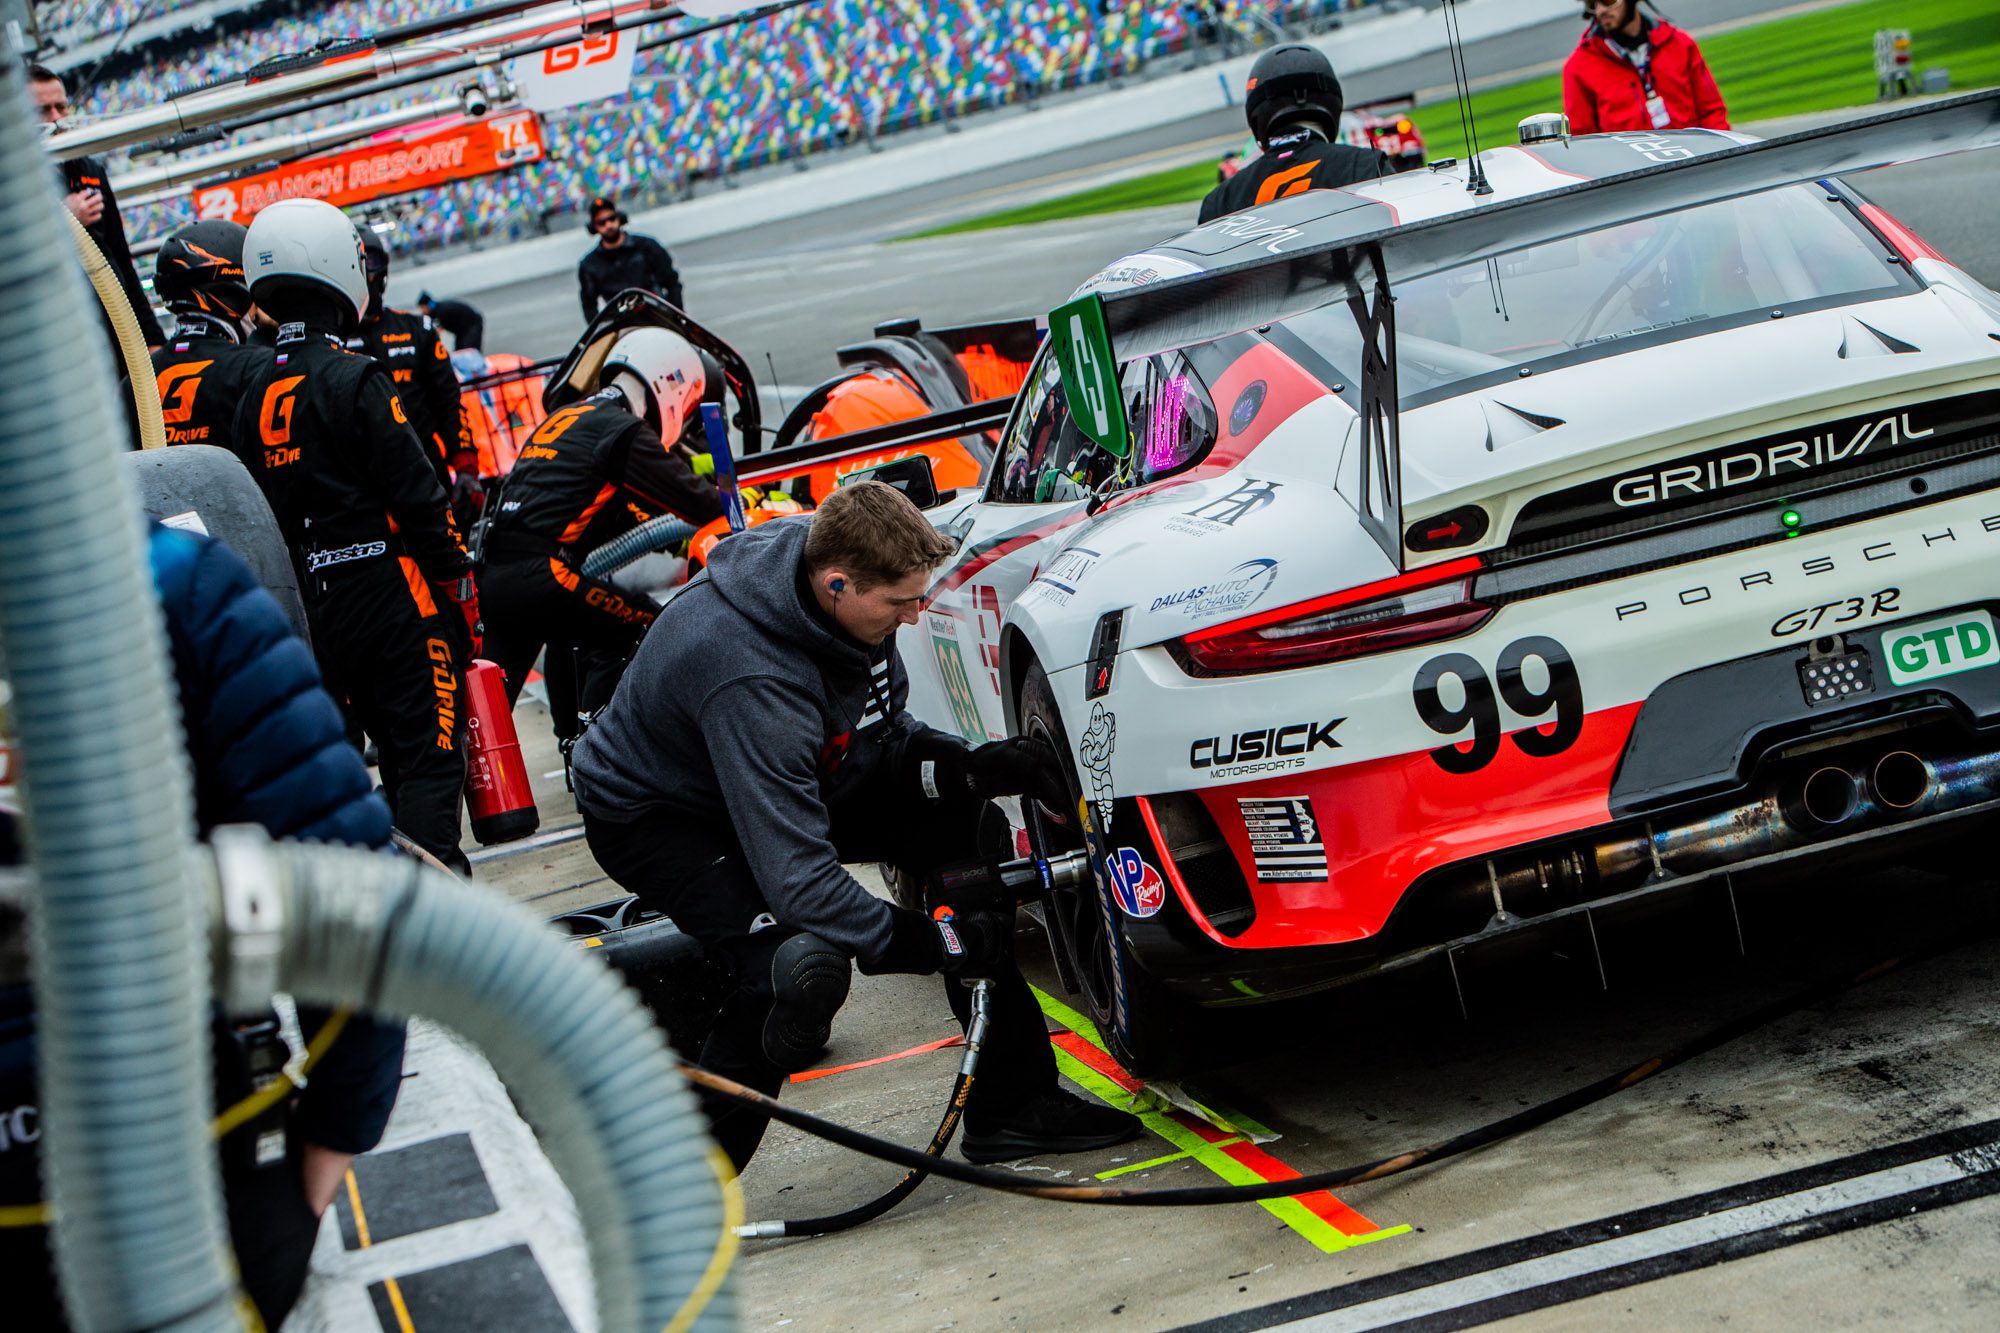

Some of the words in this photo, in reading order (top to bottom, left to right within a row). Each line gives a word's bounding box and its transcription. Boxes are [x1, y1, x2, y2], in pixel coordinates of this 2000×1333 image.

[241, 164, 345, 215] RANCH
[347, 137, 468, 190] RESORT
[166, 426, 210, 444] DRIVE
[1612, 412, 1935, 508] GRIDRIVAL
[307, 540, 386, 573] lpinestars
[1615, 514, 2000, 622] PORSCHE
[1149, 586, 1208, 613] DALLAS
[1205, 578, 1250, 596] AUTO
[1183, 589, 1255, 615] EXCHANGE
[1890, 621, 1993, 674] GTD
[938, 643, 982, 736] 99
[1413, 635, 1584, 775] 99
[1190, 716, 1349, 770] CUSICK
[1209, 756, 1306, 780] MOTORSPORTS
[1106, 847, 1145, 916] VP
[1136, 880, 1163, 906] Racing
[1093, 869, 1128, 1034] MICHELIN
